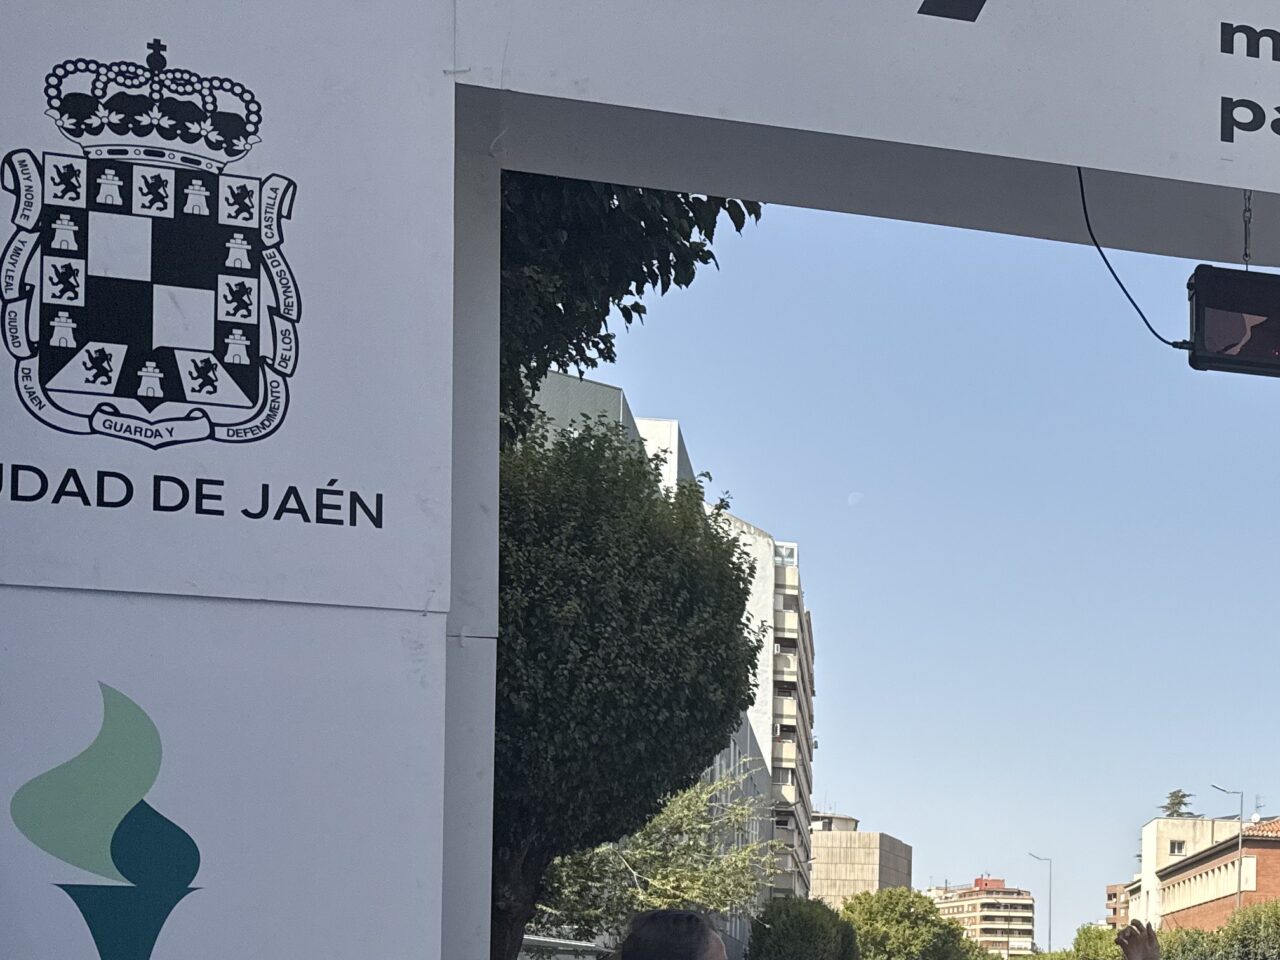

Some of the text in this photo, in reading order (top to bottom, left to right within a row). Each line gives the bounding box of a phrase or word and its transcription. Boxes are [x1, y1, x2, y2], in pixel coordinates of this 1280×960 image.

[17, 159, 34, 222] MUY NOBLE
[264, 187, 280, 239] CASTILLA
[8, 246, 23, 268] MUY
[5, 268, 15, 294] LEAL
[265, 251, 293, 316] REYNOS DE
[8, 310, 21, 348] CIUDAD
[278, 328, 293, 369] DE LOS
[21, 367, 32, 383] DE
[226, 380, 281, 437] DEFENDIMENTO
[102, 419, 174, 440] GUARDA Y
[0, 464, 384, 529] DAD DE JAÉN
